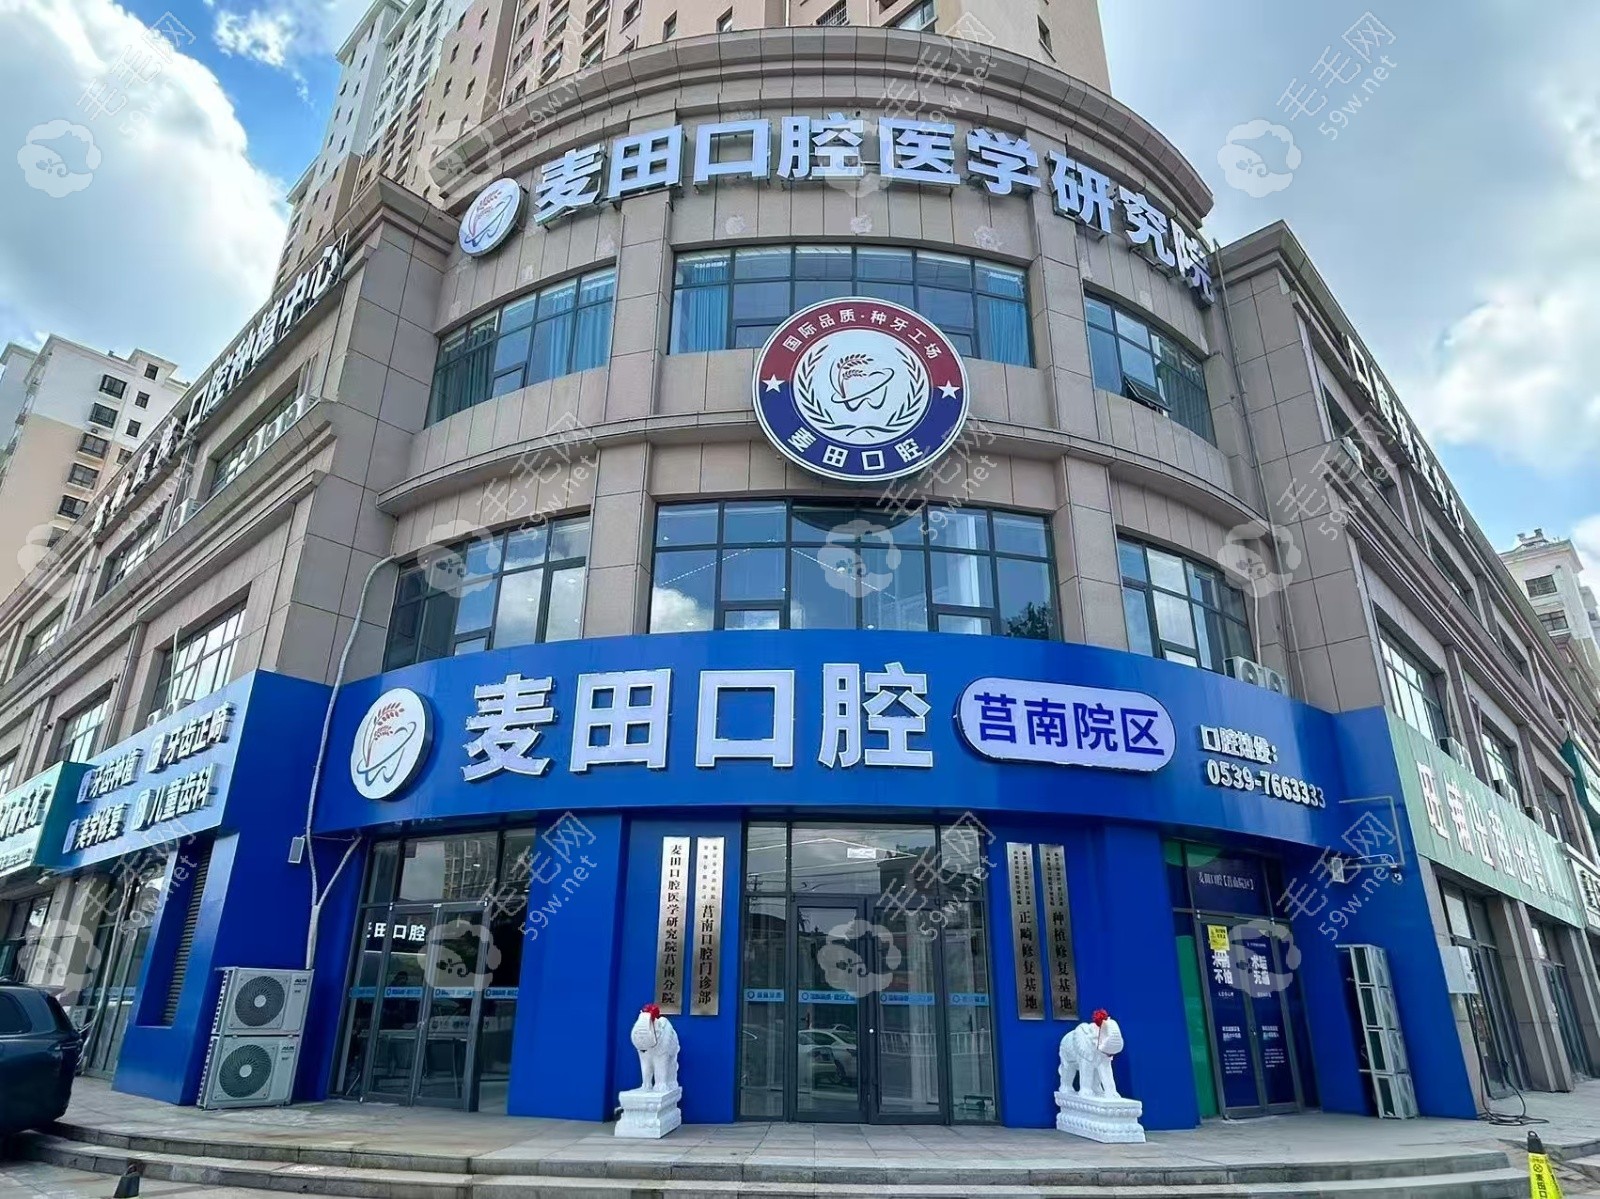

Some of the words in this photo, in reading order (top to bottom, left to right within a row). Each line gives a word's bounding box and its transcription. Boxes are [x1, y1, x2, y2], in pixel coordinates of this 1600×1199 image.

[533, 112, 1215, 303] 麦田口腔医学研究院
[782, 308, 942, 359] 国际品质·种牙工场
[788, 426, 923, 471] 麦田口腔
[461, 661, 934, 782] 麦田口腔
[974, 692, 1166, 757] 莒南院区
[1206, 758, 1327, 808] 0539-7663333
[699, 904, 715, 1005] 莒南口腔门诊部
